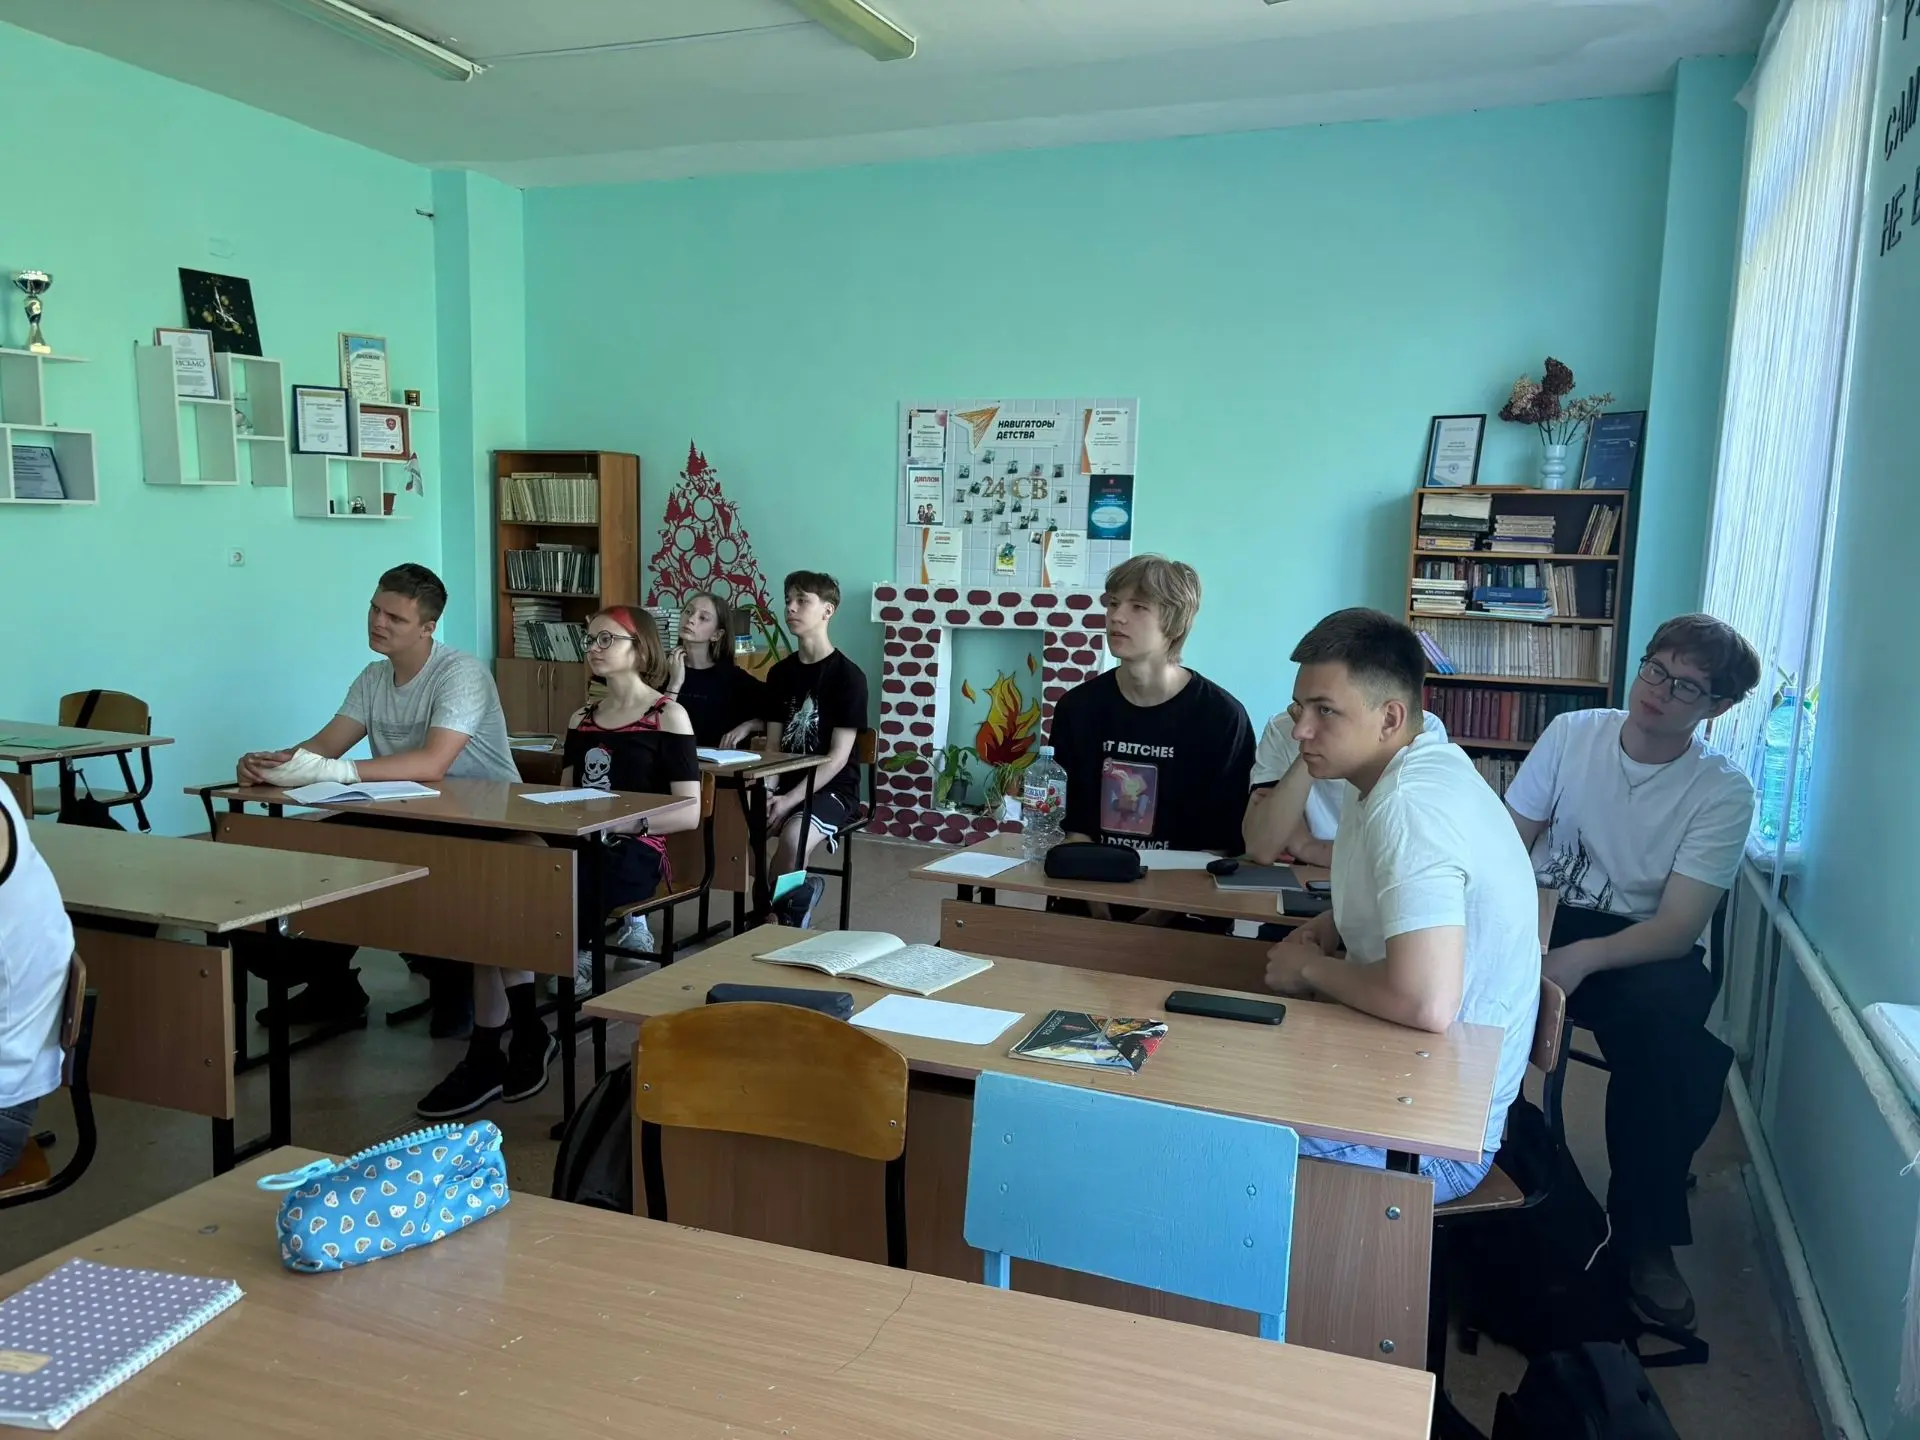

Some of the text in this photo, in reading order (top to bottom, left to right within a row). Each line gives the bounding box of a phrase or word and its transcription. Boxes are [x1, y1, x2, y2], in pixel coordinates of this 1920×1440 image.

[1880, 183, 1906, 257] НЕ
[998, 419, 1056, 429] НАВИГАТОРЫ
[996, 430, 1035, 441] ДЕТСТВА
[981, 475, 1006, 499] 24
[1117, 741, 1174, 758] BITCHES
[1107, 836, 1169, 850] DISTANCE
